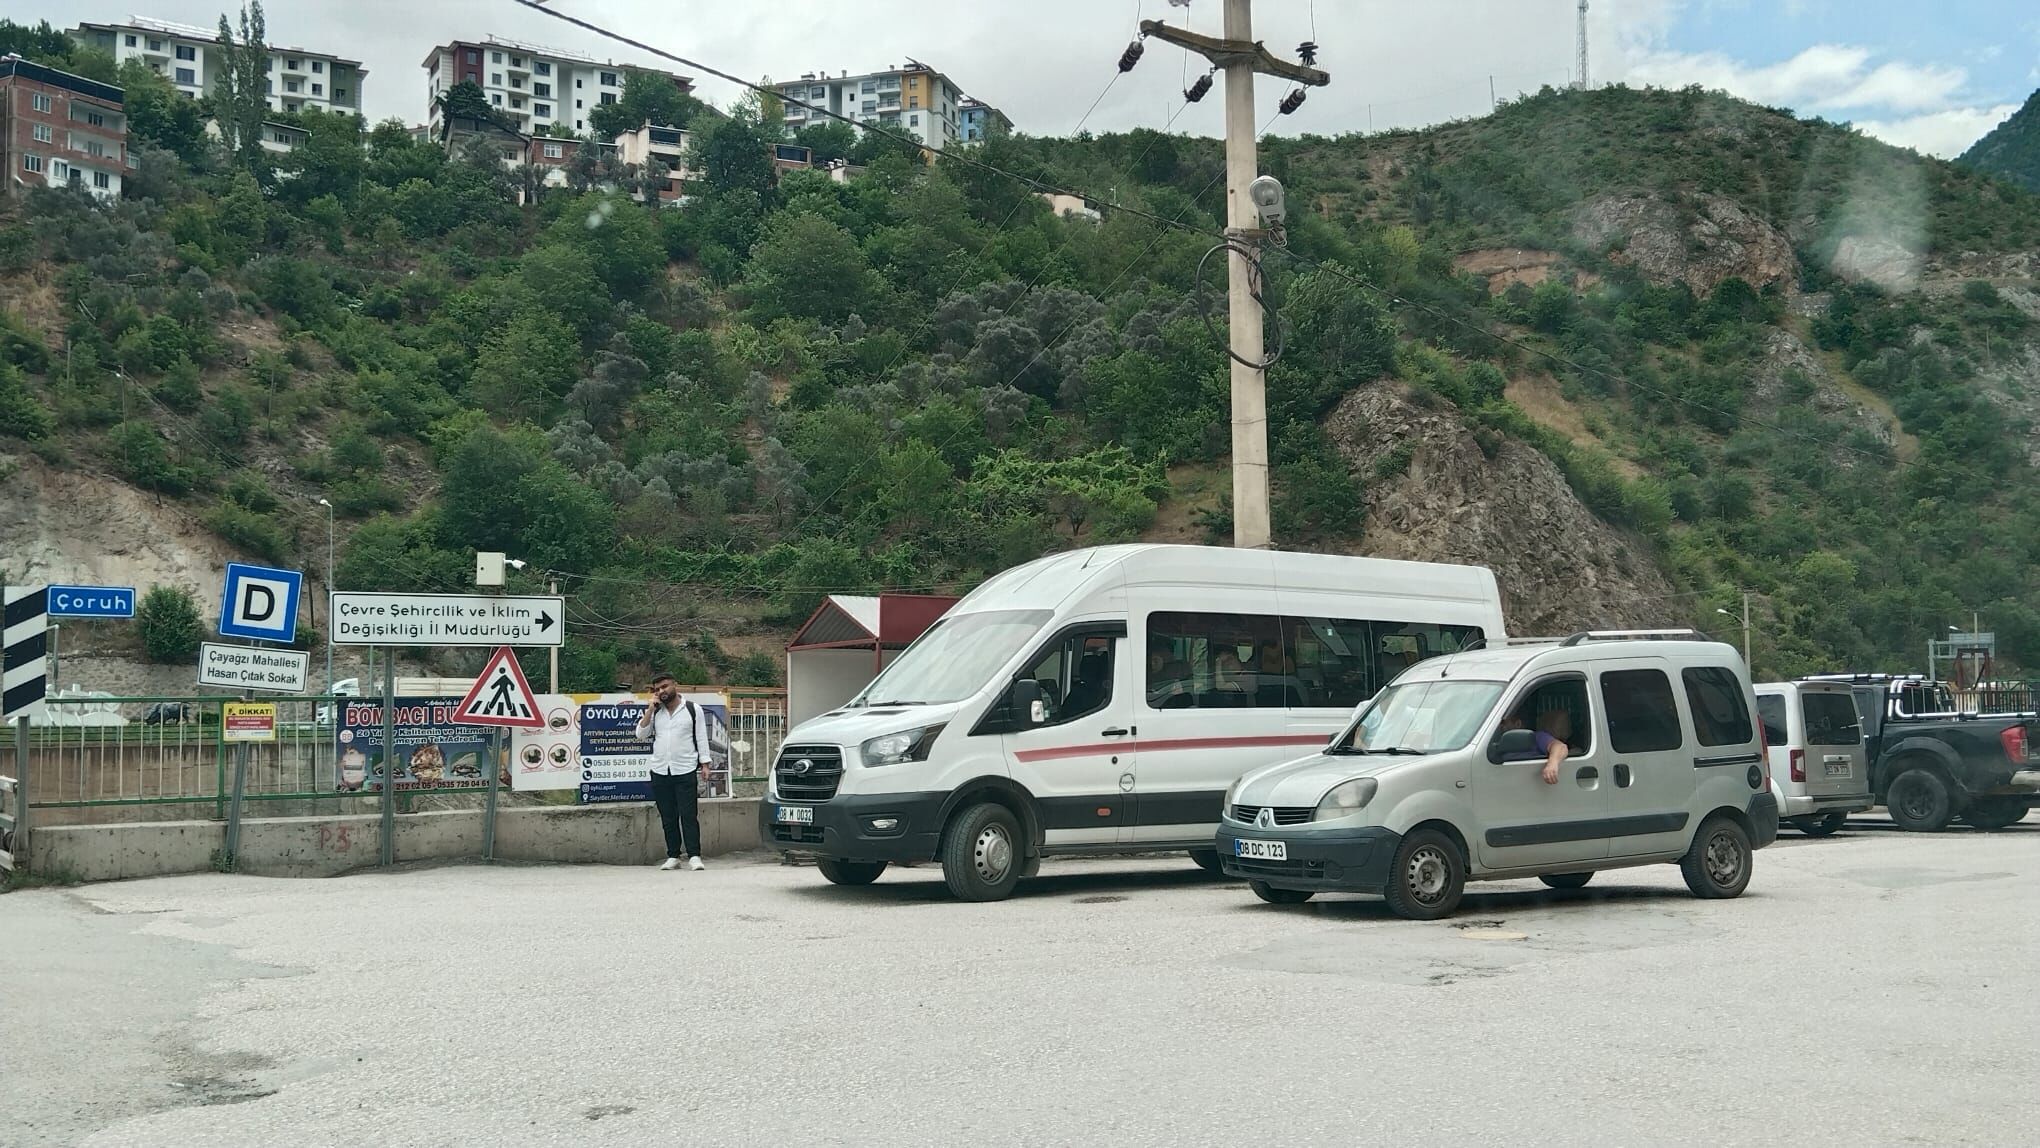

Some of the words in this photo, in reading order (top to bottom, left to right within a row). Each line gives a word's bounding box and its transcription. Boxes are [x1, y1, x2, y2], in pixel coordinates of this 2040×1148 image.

[56, 593, 126, 611] Çoruh
[242, 583, 275, 622] D
[340, 603, 385, 618] Çevre
[390, 603, 463, 618] Şehircilik
[469, 608, 486, 617] ve
[492, 602, 530, 618] İklim
[340, 621, 423, 637] Değişikliği
[429, 620, 438, 635] İl
[445, 622, 530, 638] Müdürlüğü
[209, 650, 249, 666] Çayağzı
[252, 654, 300, 669] Mahallesi
[207, 667, 238, 679] Hasan
[240, 669, 265, 682] Çıtak
[267, 672, 298, 684] Sokak
[586, 707, 619, 720] ÖYKÜ
[429, 735, 447, 744] Tek
[1240, 842, 1250, 855] 08
[1251, 843, 1265, 856] DC
[1267, 844, 1284, 857] 123
